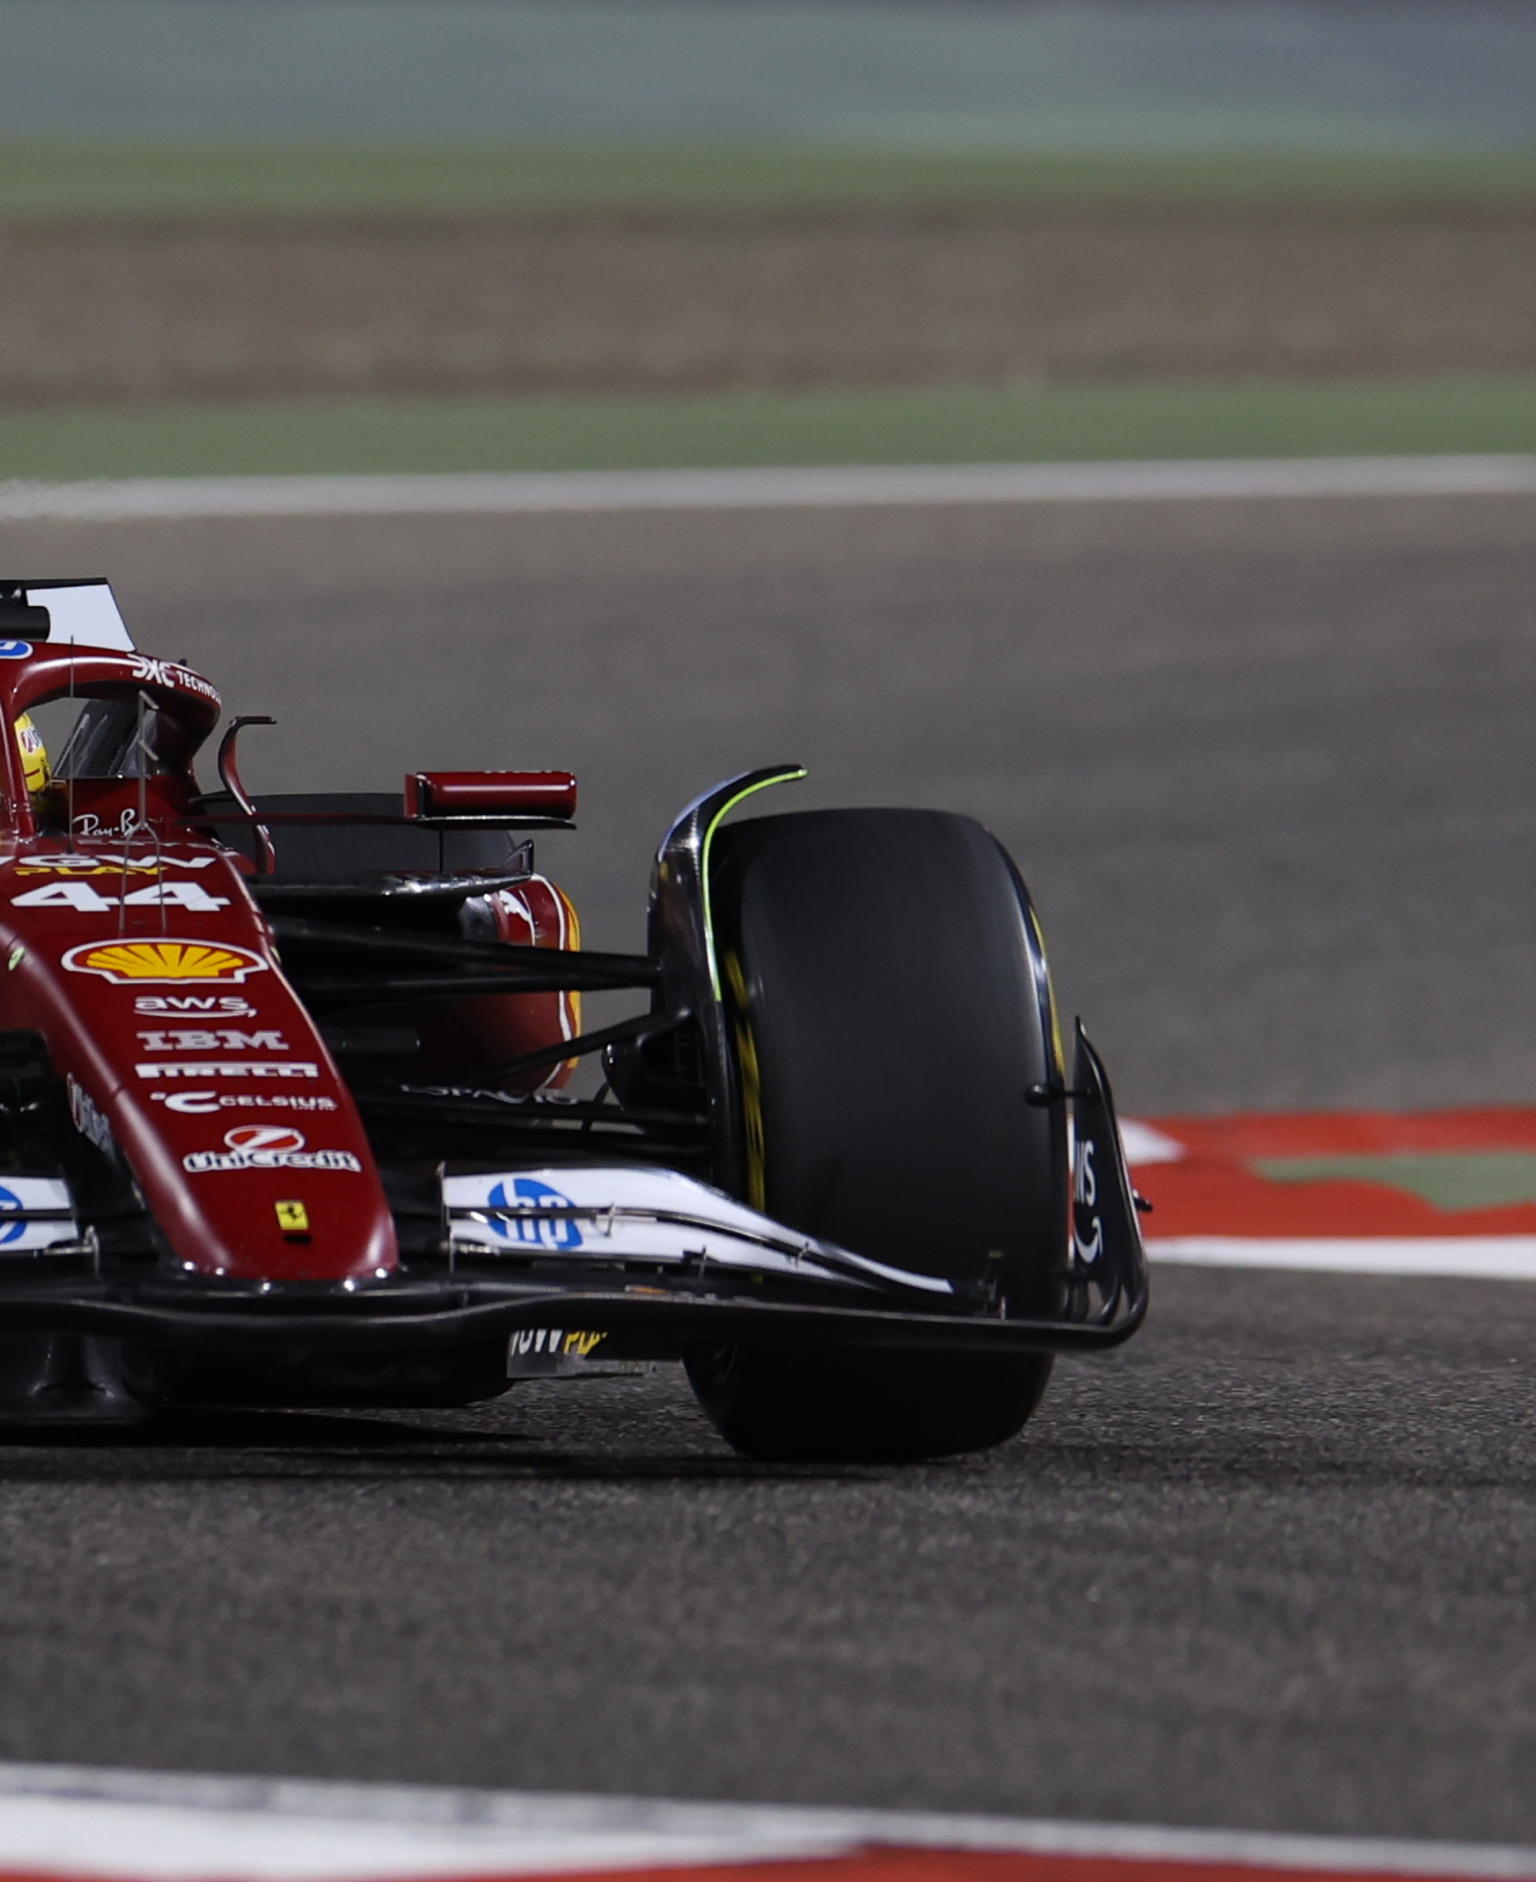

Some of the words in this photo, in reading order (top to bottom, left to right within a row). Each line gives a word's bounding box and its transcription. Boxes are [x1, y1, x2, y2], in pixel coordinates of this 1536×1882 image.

[13, 866, 167, 876] PLAY
[10, 881, 231, 912] 44
[134, 996, 254, 1014] aws
[136, 1029, 290, 1052] IBM
[134, 1061, 321, 1079] PIRELLI
[183, 1149, 362, 1173] UniCredit
[500, 1179, 570, 1250] hp
